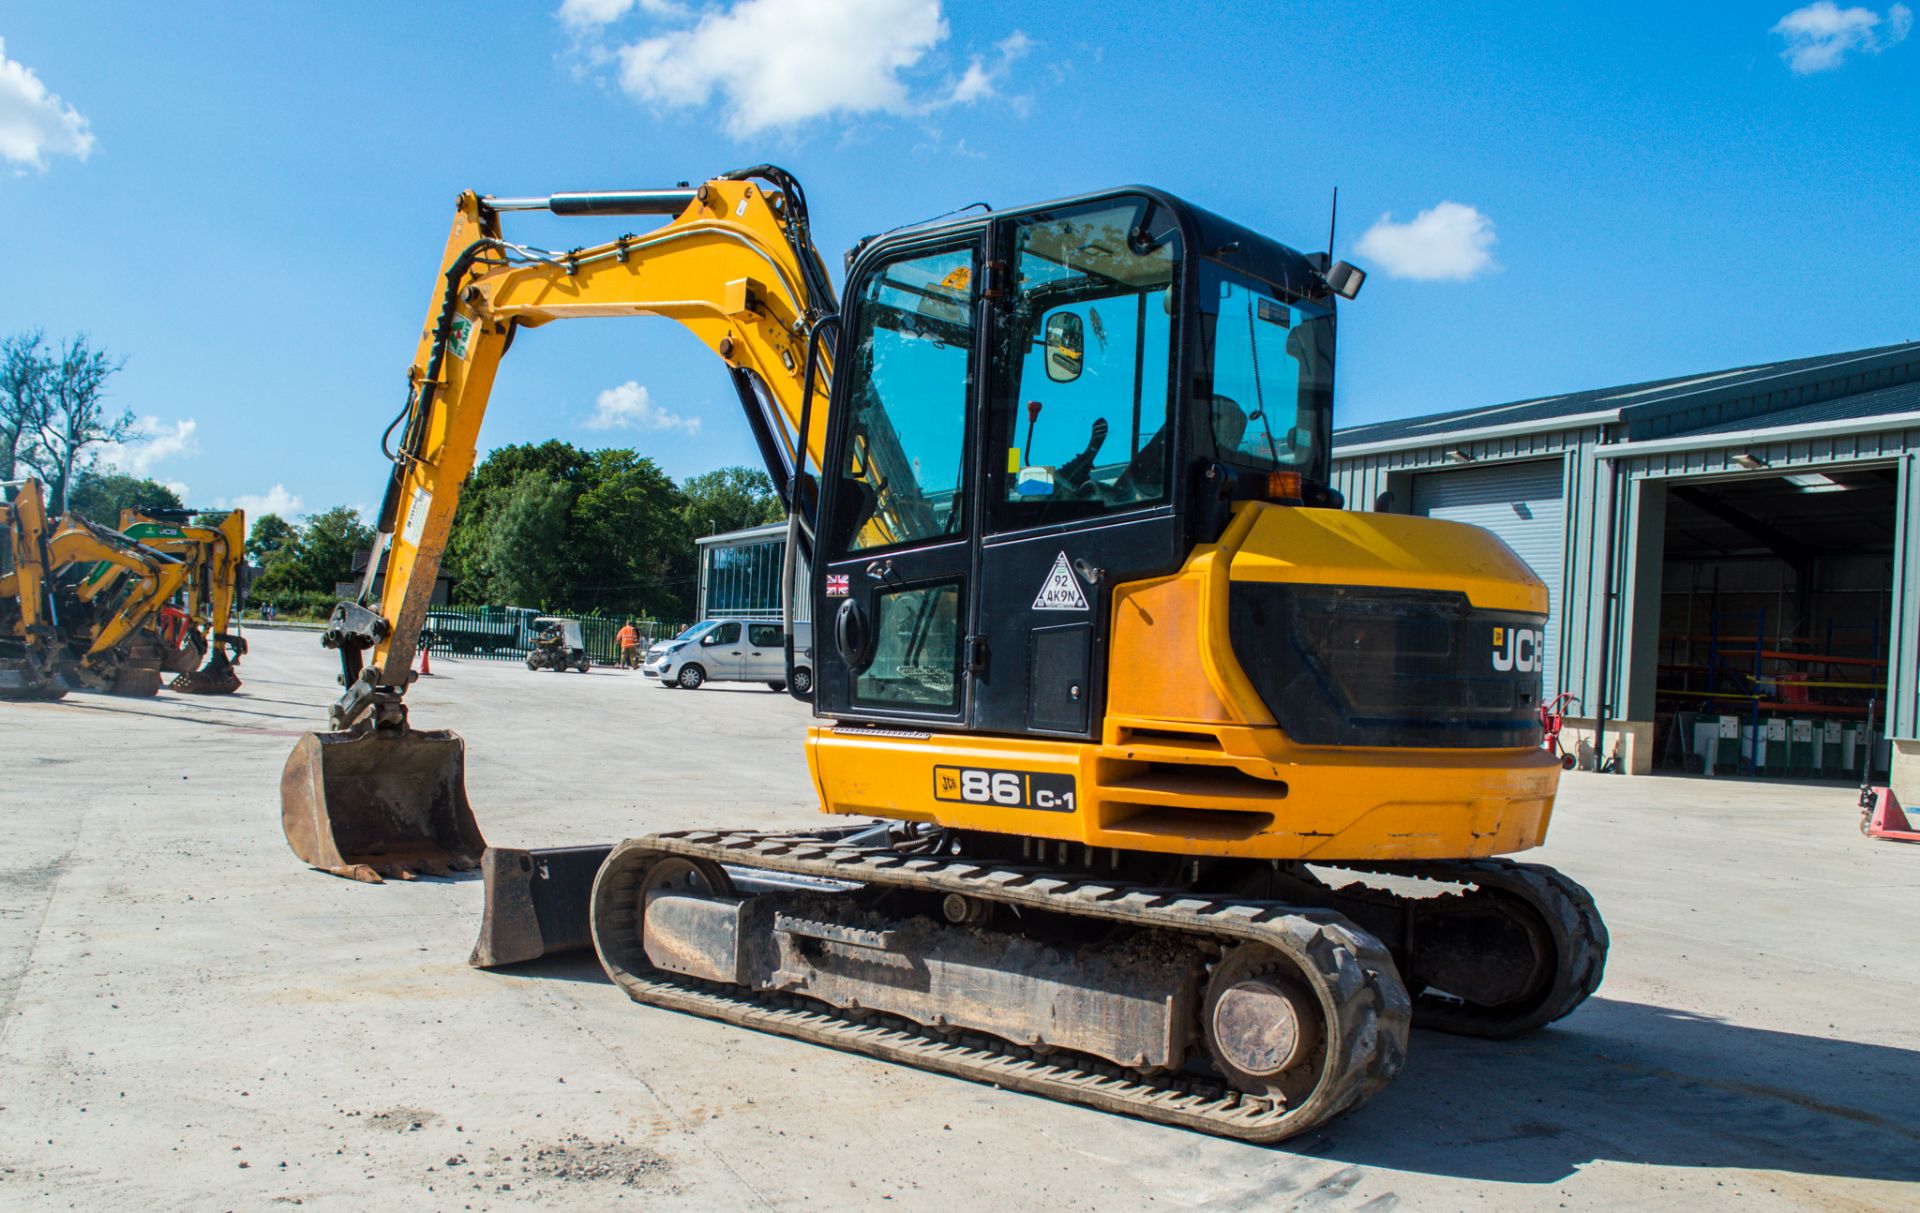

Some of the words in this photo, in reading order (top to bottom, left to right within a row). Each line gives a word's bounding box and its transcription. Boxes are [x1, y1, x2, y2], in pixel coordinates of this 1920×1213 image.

[159, 527, 178, 536] JCB
[1055, 575, 1068, 587] 92
[1047, 590, 1075, 602] AK9N
[942, 776, 957, 790] JCB
[962, 770, 1020, 805] 86
[1036, 790, 1074, 809] C-1
